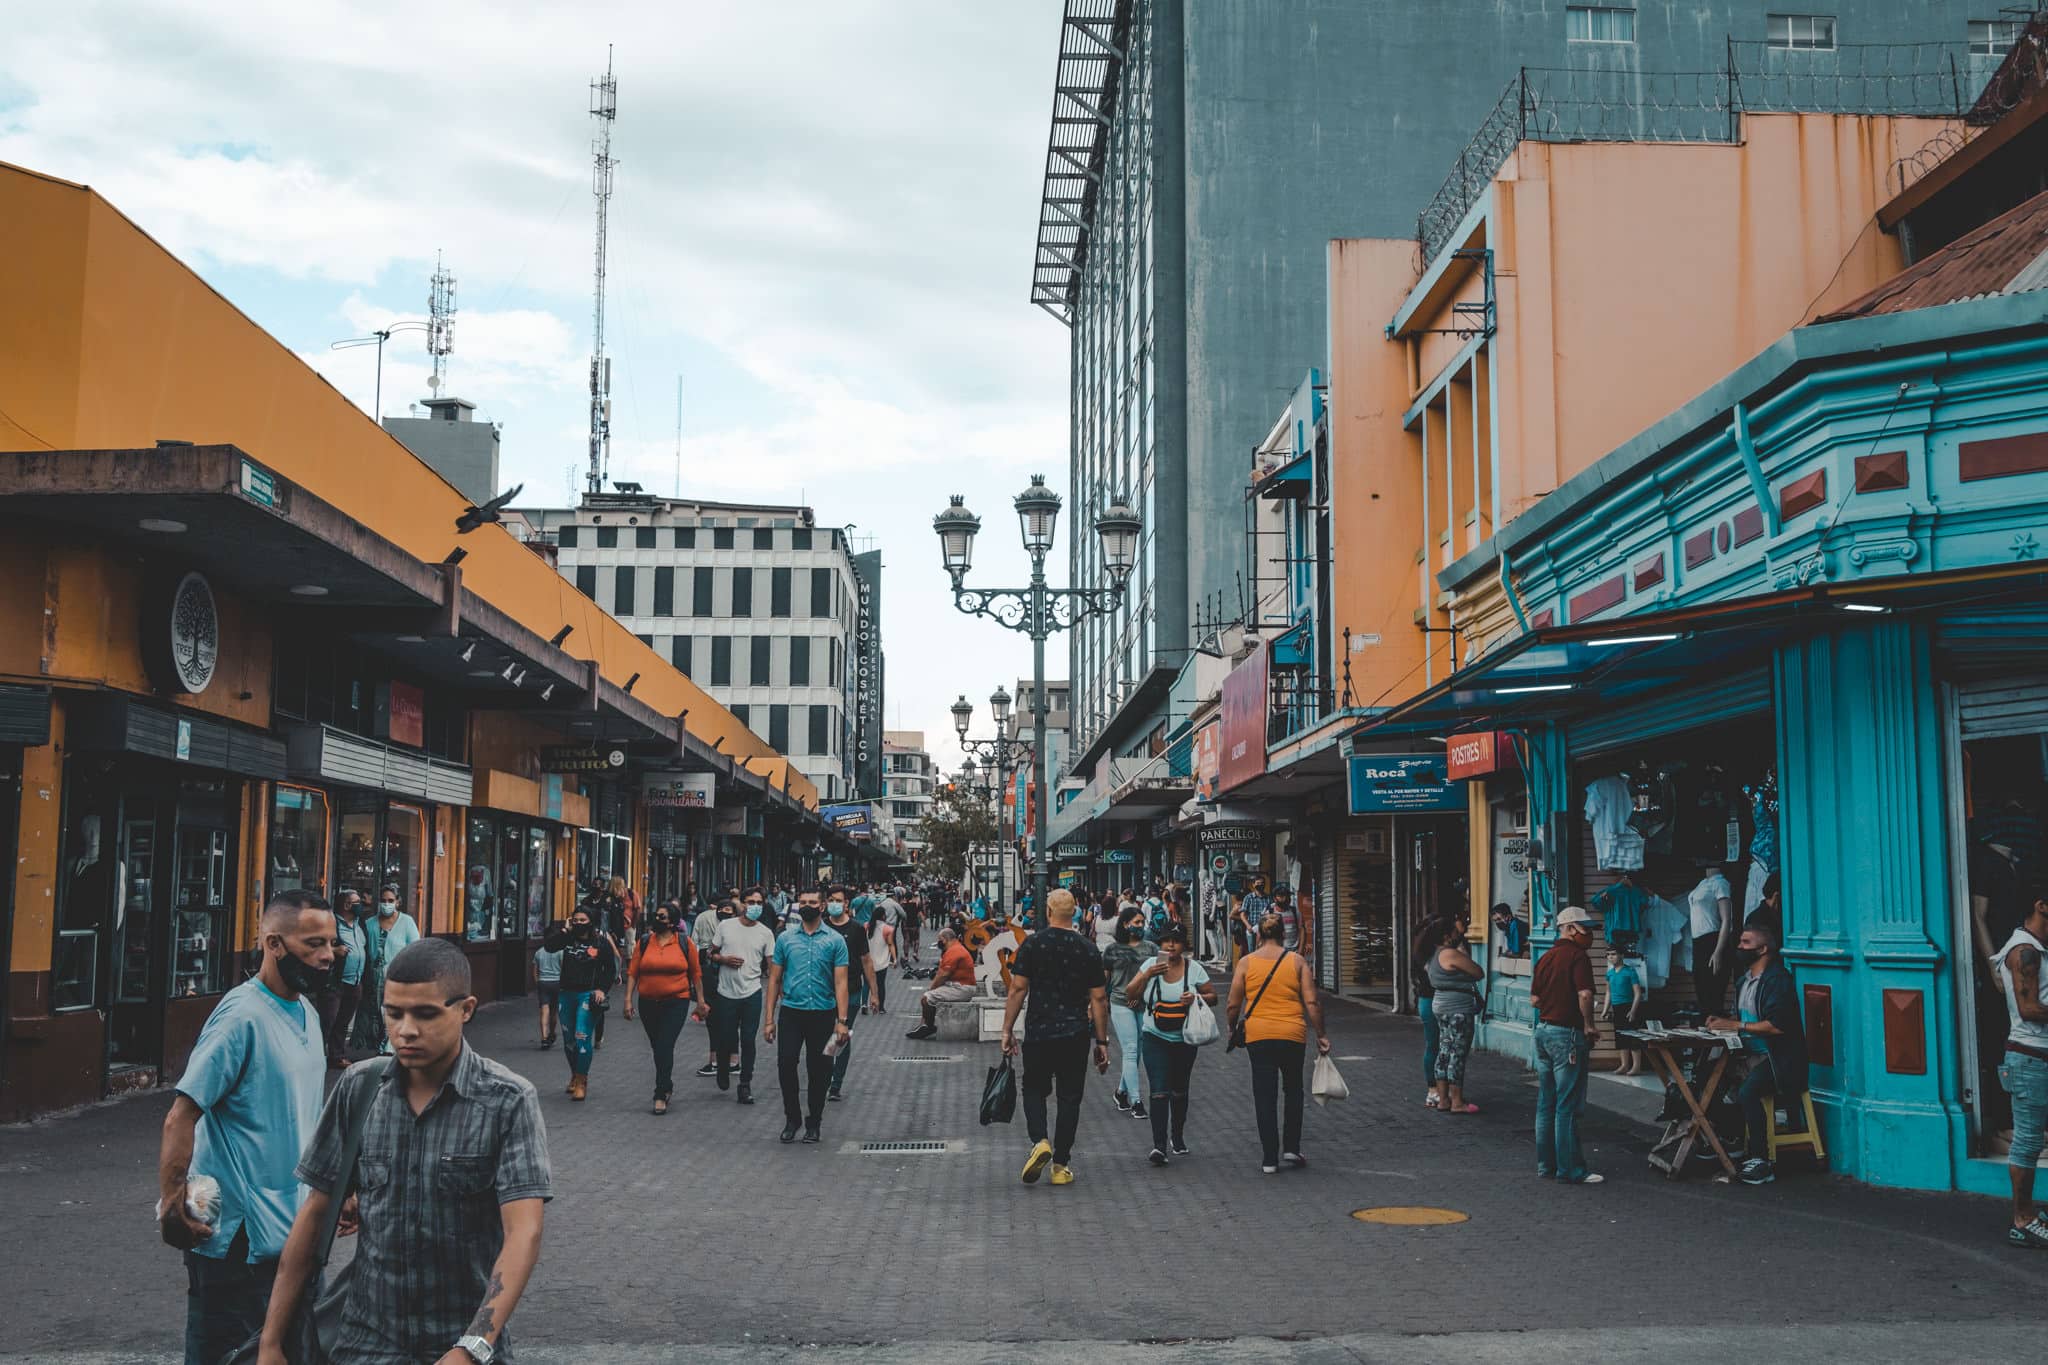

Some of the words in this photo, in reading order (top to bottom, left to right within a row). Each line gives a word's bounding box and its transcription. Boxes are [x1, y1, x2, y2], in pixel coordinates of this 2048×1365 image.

[860, 583, 870, 641] MUNDO
[175, 643, 193, 657] TREE
[870, 624, 878, 721] PROFESSIONAL
[858, 655, 869, 762] COSMÉTICO
[1451, 741, 1480, 768] POSTRES
[1365, 768, 1407, 779] Roca
[1200, 829, 1264, 841] PANECILLOS
